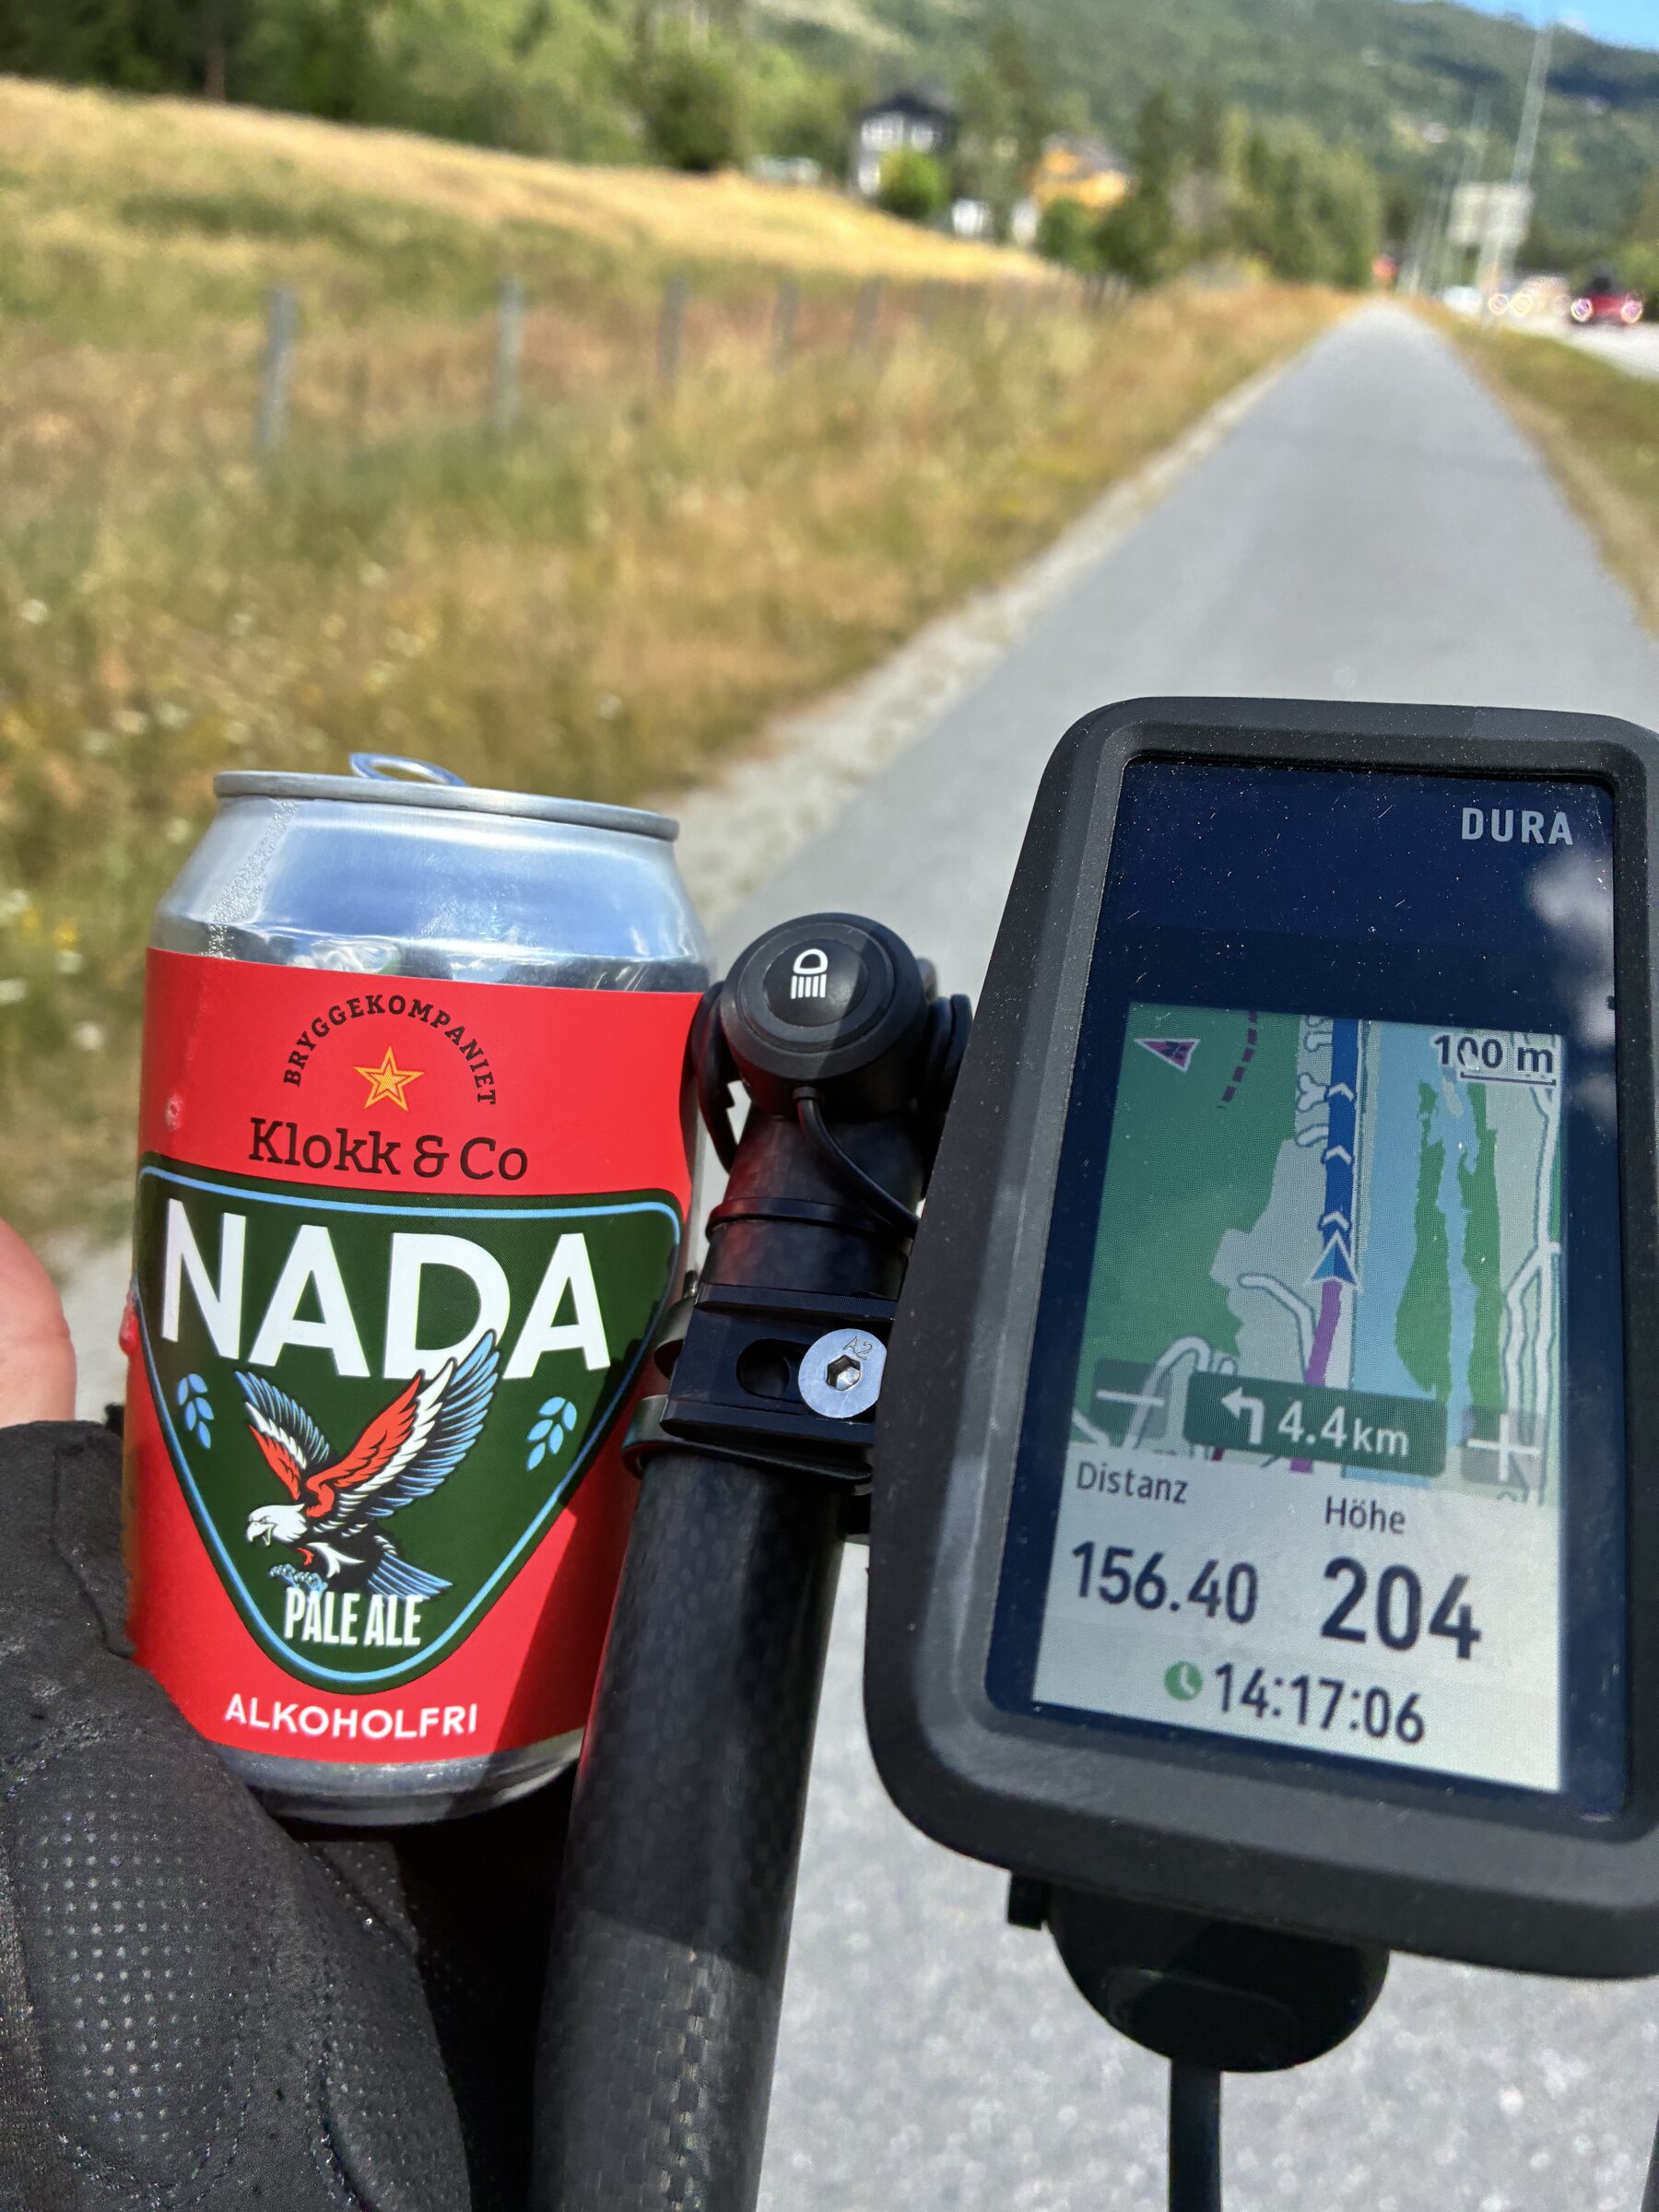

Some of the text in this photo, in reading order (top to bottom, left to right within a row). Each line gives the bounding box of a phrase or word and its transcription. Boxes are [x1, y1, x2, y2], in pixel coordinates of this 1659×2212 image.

[1461, 807, 1573, 845] DURA
[284, 994, 496, 1106] BRYGGEKOMPANIET
[1434, 1034, 1554, 1074] 100 m
[248, 1118, 529, 1181] Klokk & Co
[160, 1198, 612, 1382] NADA
[842, 1335, 874, 1361] A2
[1077, 1462, 1190, 1504] Distanz
[1324, 1496, 1406, 1535] Höhe
[1071, 1541, 1259, 1624] 156.40
[1321, 1557, 1482, 1660] 204
[283, 1587, 423, 1647] PALE ALE
[224, 1693, 477, 1740] ALKOHOLFRI
[1215, 1663, 1426, 1745] 14:17:06
